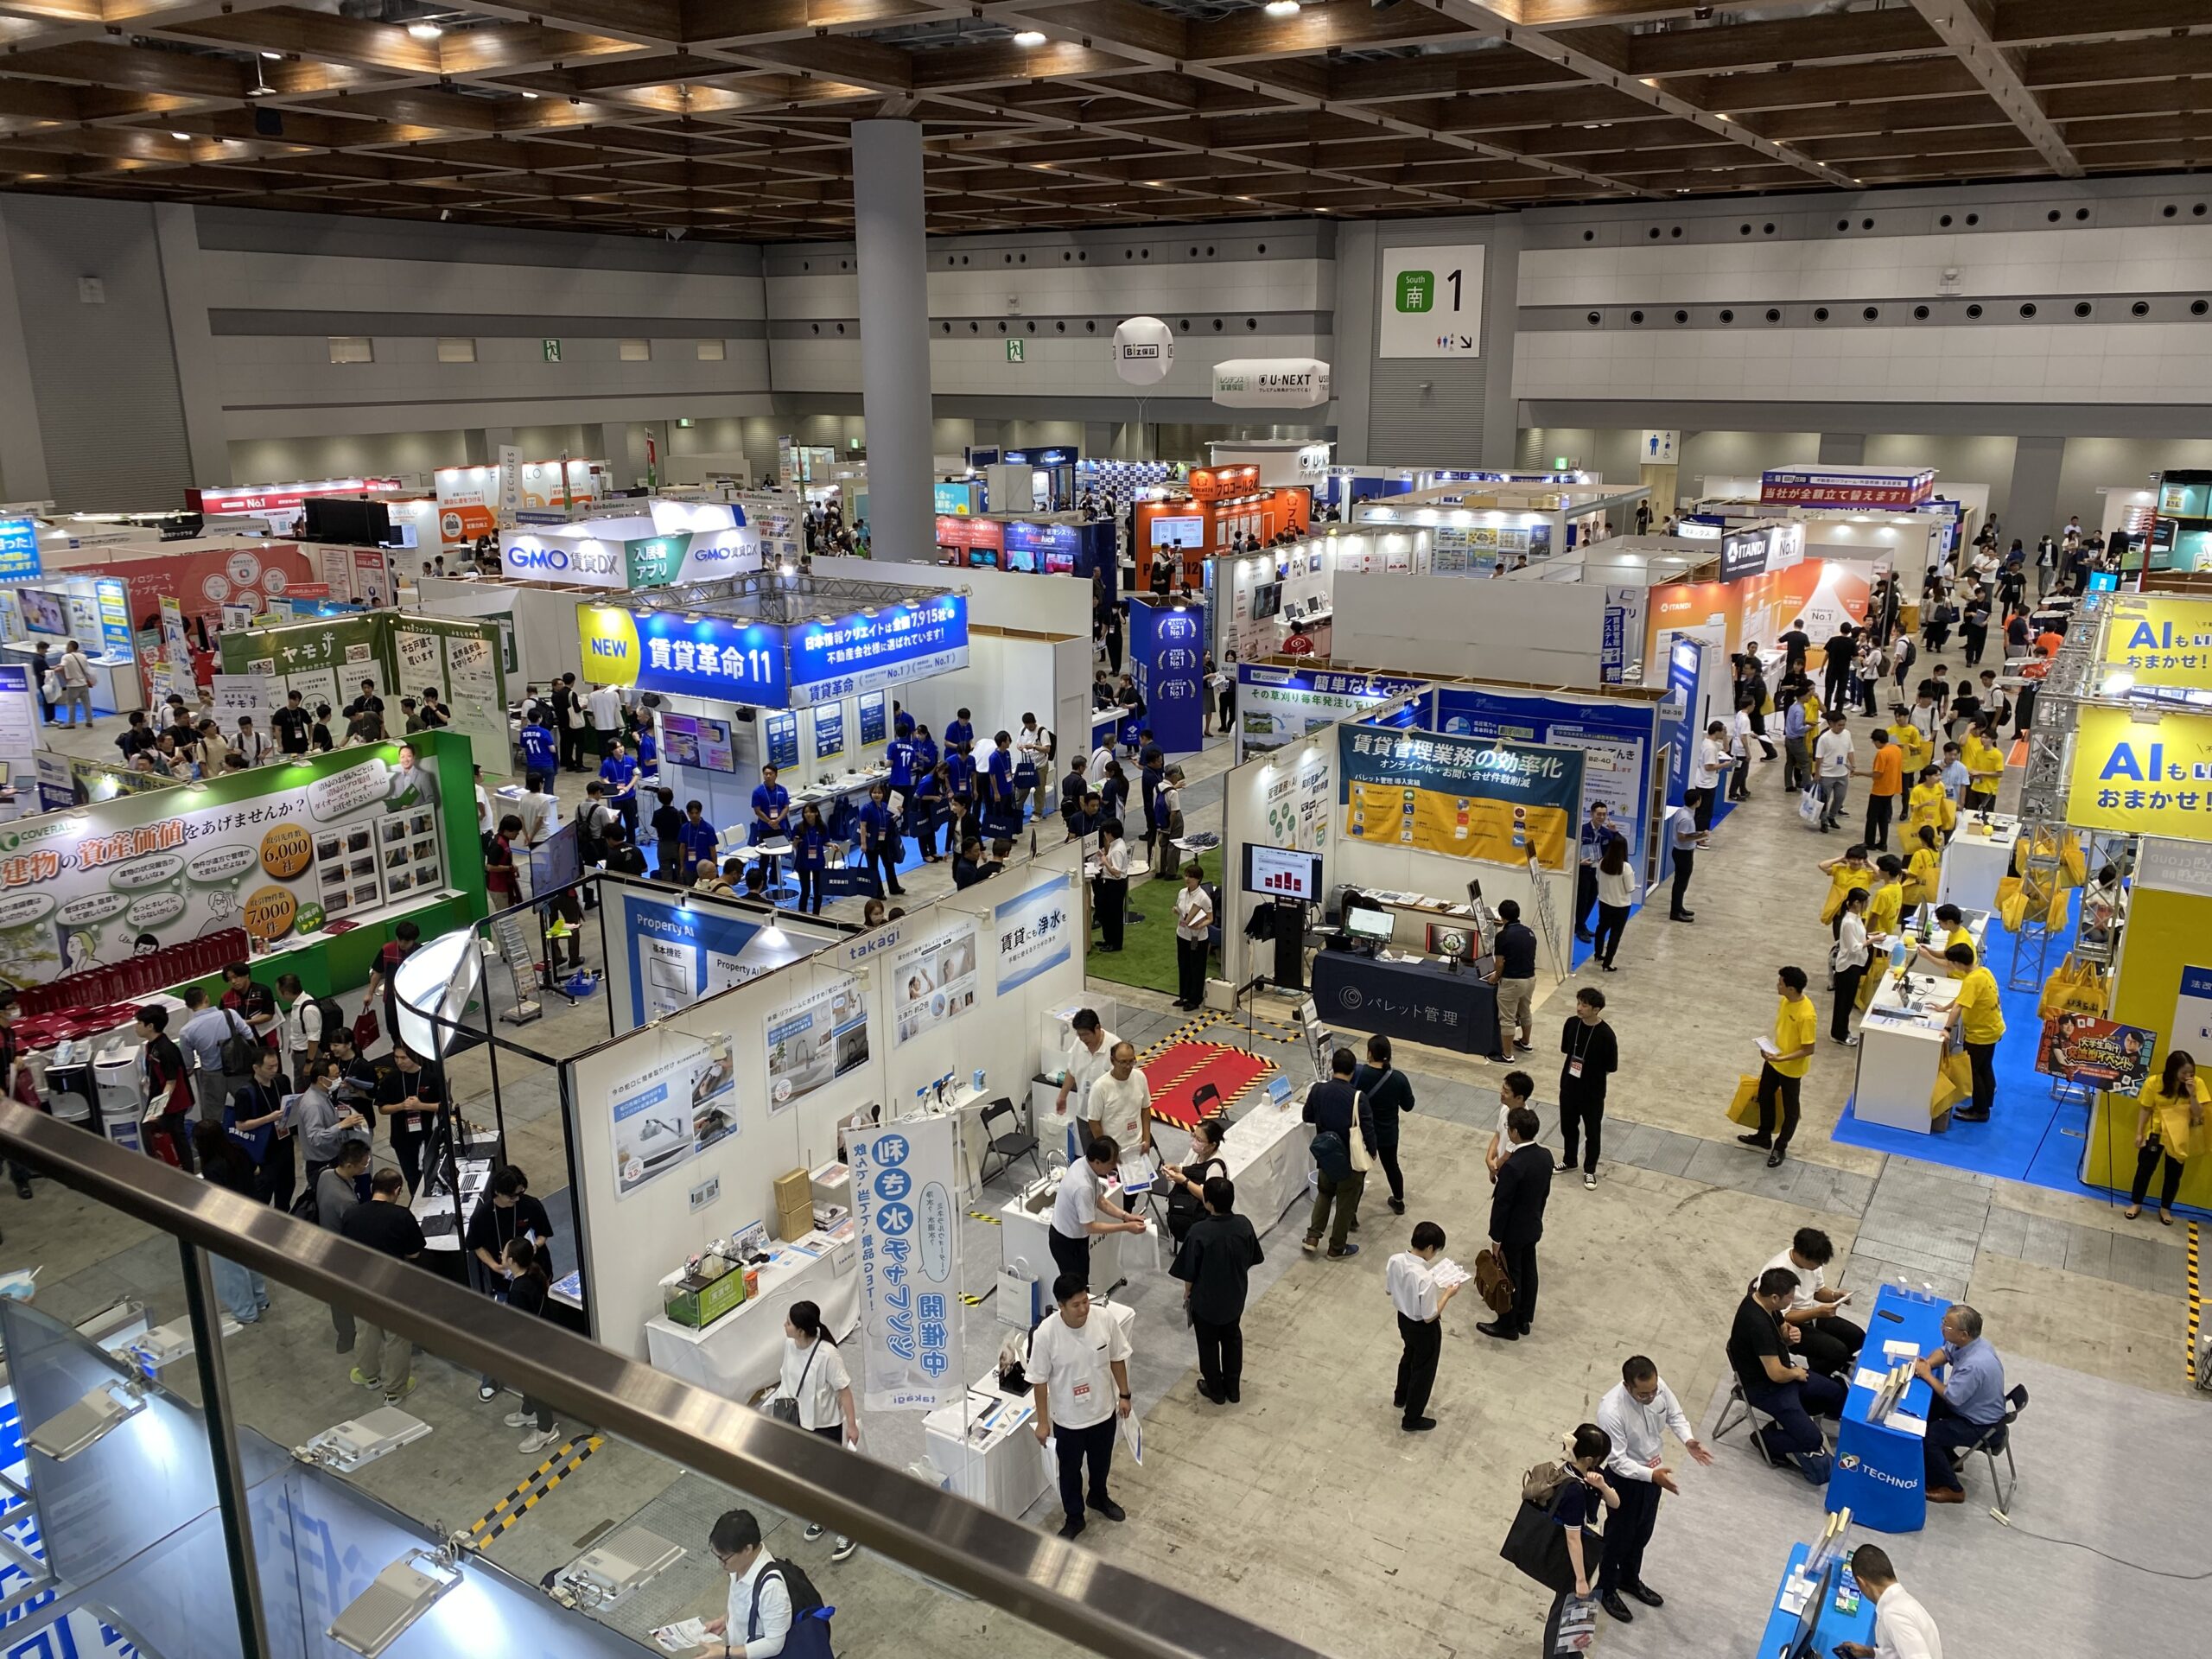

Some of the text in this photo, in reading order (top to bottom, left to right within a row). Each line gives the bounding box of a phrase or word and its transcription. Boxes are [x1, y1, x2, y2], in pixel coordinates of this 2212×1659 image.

[1406, 275, 1425, 284] South
[1406, 285, 1424, 309] 南
[1446, 269, 1462, 312] 1
[1270, 374, 1311, 385] U-NEXT
[634, 543, 668, 563] 入居者
[1738, 540, 1766, 558] ITANDI
[1779, 539, 1796, 556] No.1
[635, 563, 668, 580] アプリ
[1669, 602, 1692, 611] ITANDI
[1811, 613, 1832, 621] No.1
[1170, 626, 1185, 636] No.1
[282, 632, 335, 663] ヤモリ
[401, 637, 433, 655] 中古戸建て
[591, 637, 627, 658] NEW
[407, 649, 434, 666] 買います
[450, 650, 488, 671] 見守りセンサー
[1170, 656, 1185, 667] No.1
[2126, 654, 2207, 669] おまかせ！
[809, 677, 854, 702] 賃貸革命
[887, 666, 904, 679] No.1
[934, 655, 950, 667] No.1
[1169, 686, 1184, 696] No.1
[1662, 709, 1682, 717] B2-39
[526, 739, 541, 754] 11
[899, 750, 912, 766] 11
[1351, 733, 1565, 779] 賃貸管理業務の効率化
[1588, 756, 1611, 765] B2-40
[1379, 759, 1532, 788] オンライン化・お問い合せ件数削減
[318, 832, 337, 841] Before
[264, 838, 308, 863] 6,000
[282, 860, 295, 874] 社
[247, 900, 290, 926] 7,000
[265, 921, 278, 936] 件
[637, 913, 695, 938] Property AI
[1001, 910, 1067, 954] 賃貸にも浄水を
[652, 943, 682, 959] 基本機能
[849, 930, 900, 961] takagi
[716, 958, 751, 975] Property
[1368, 996, 1459, 1027] パレット管理
[1862, 1464, 1918, 1490] TECHNOS
